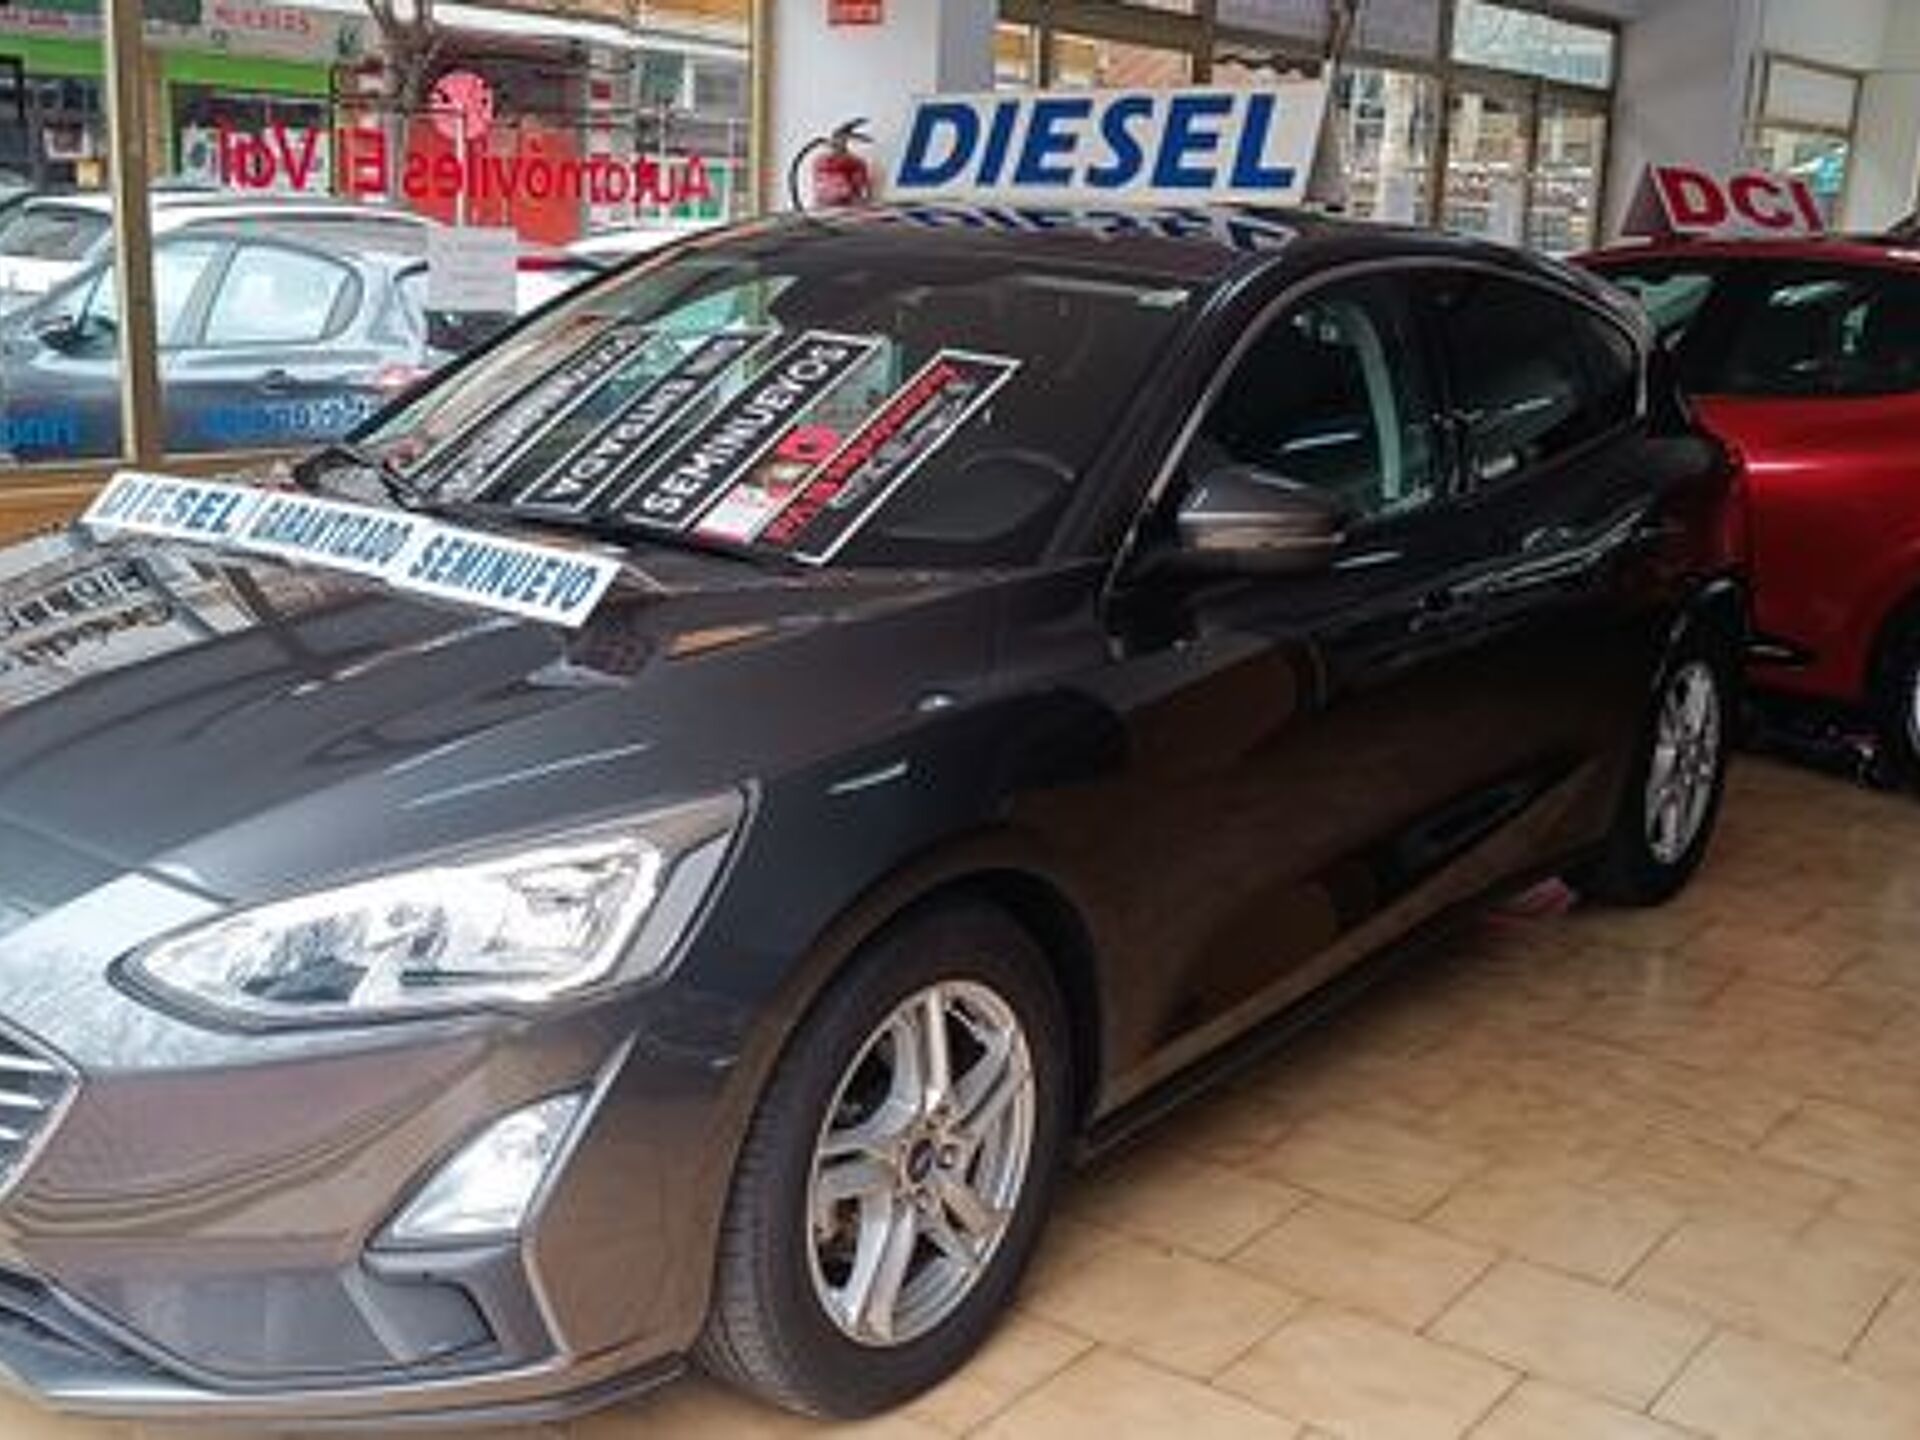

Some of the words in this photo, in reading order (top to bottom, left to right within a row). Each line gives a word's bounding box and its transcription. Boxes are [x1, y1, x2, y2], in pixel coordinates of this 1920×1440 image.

[897, 94, 1296, 188] DIESEL
[1655, 165, 1824, 232] DCI
[642, 346, 848, 514] SEMINUEVOS
[97, 477, 246, 535] DIESEL
[408, 534, 599, 612] SEMINUEVO
